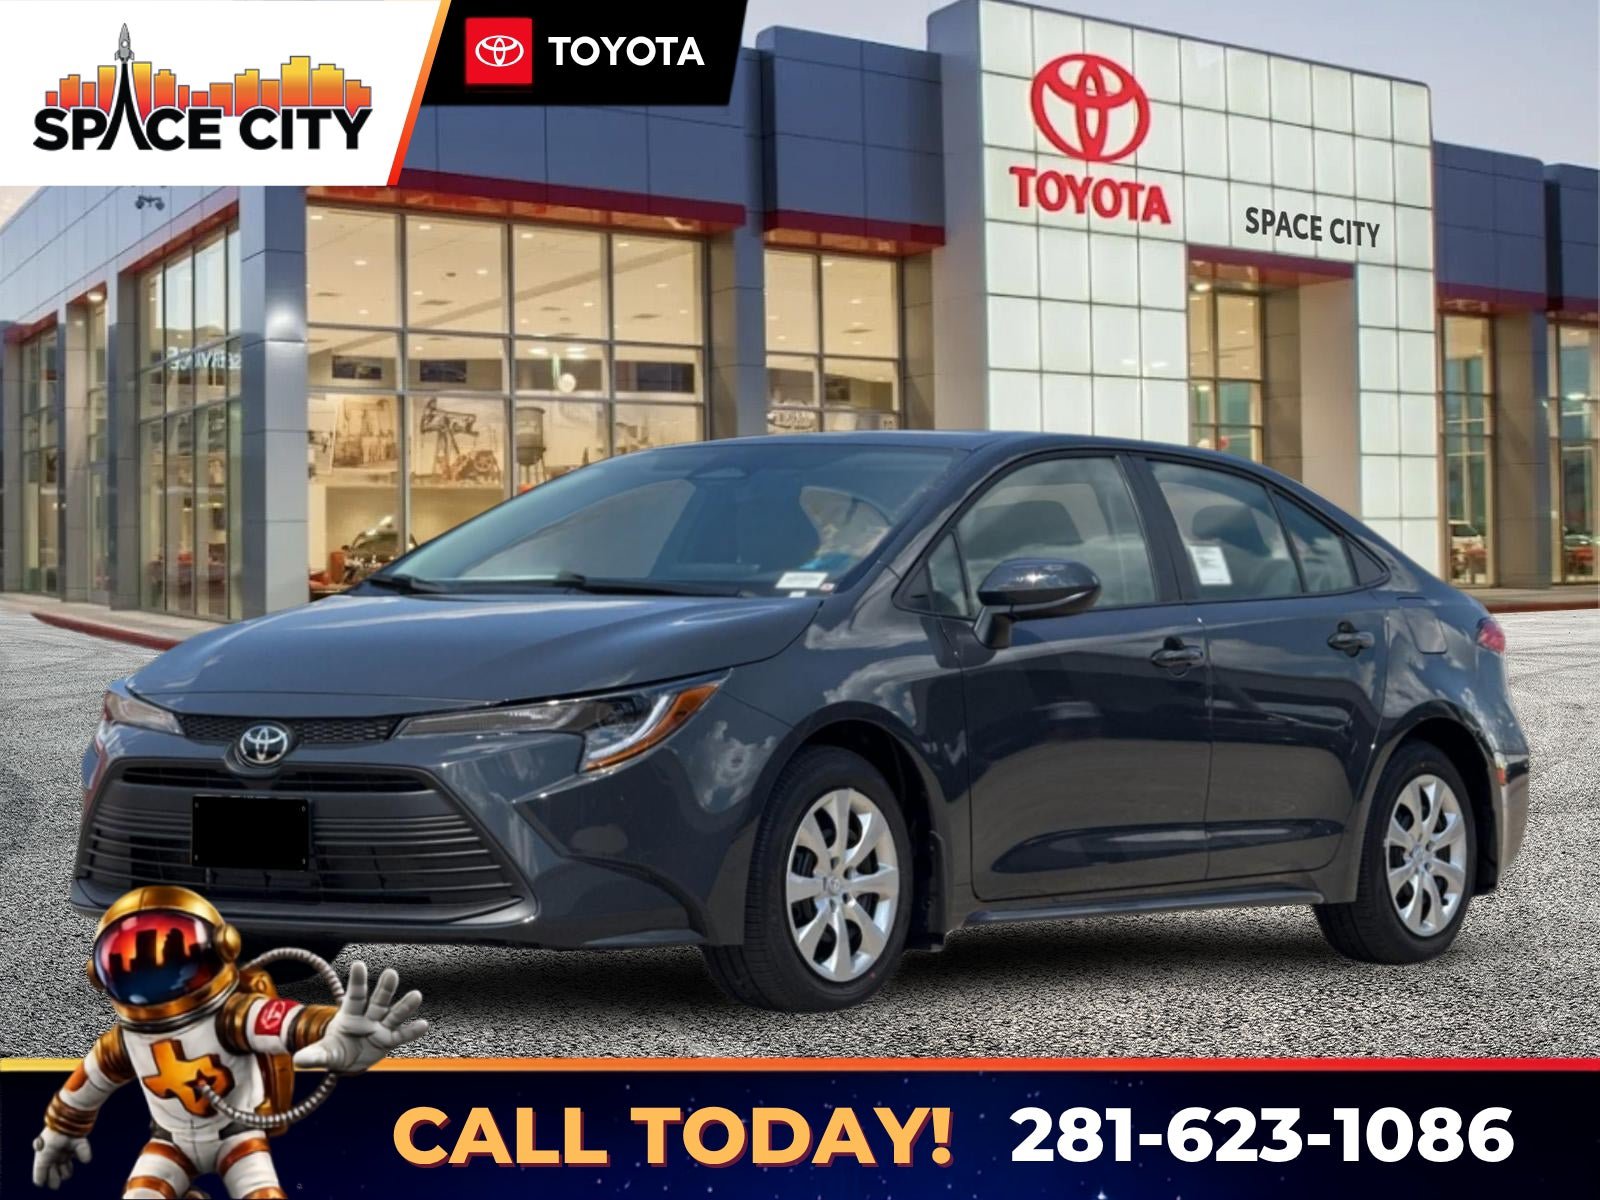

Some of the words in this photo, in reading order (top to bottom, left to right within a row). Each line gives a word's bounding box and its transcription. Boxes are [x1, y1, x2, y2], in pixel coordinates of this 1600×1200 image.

[1009, 166, 1170, 224] TOYOTA
[1245, 206, 1324, 242] SPACE
[1328, 217, 1381, 248] CITY
